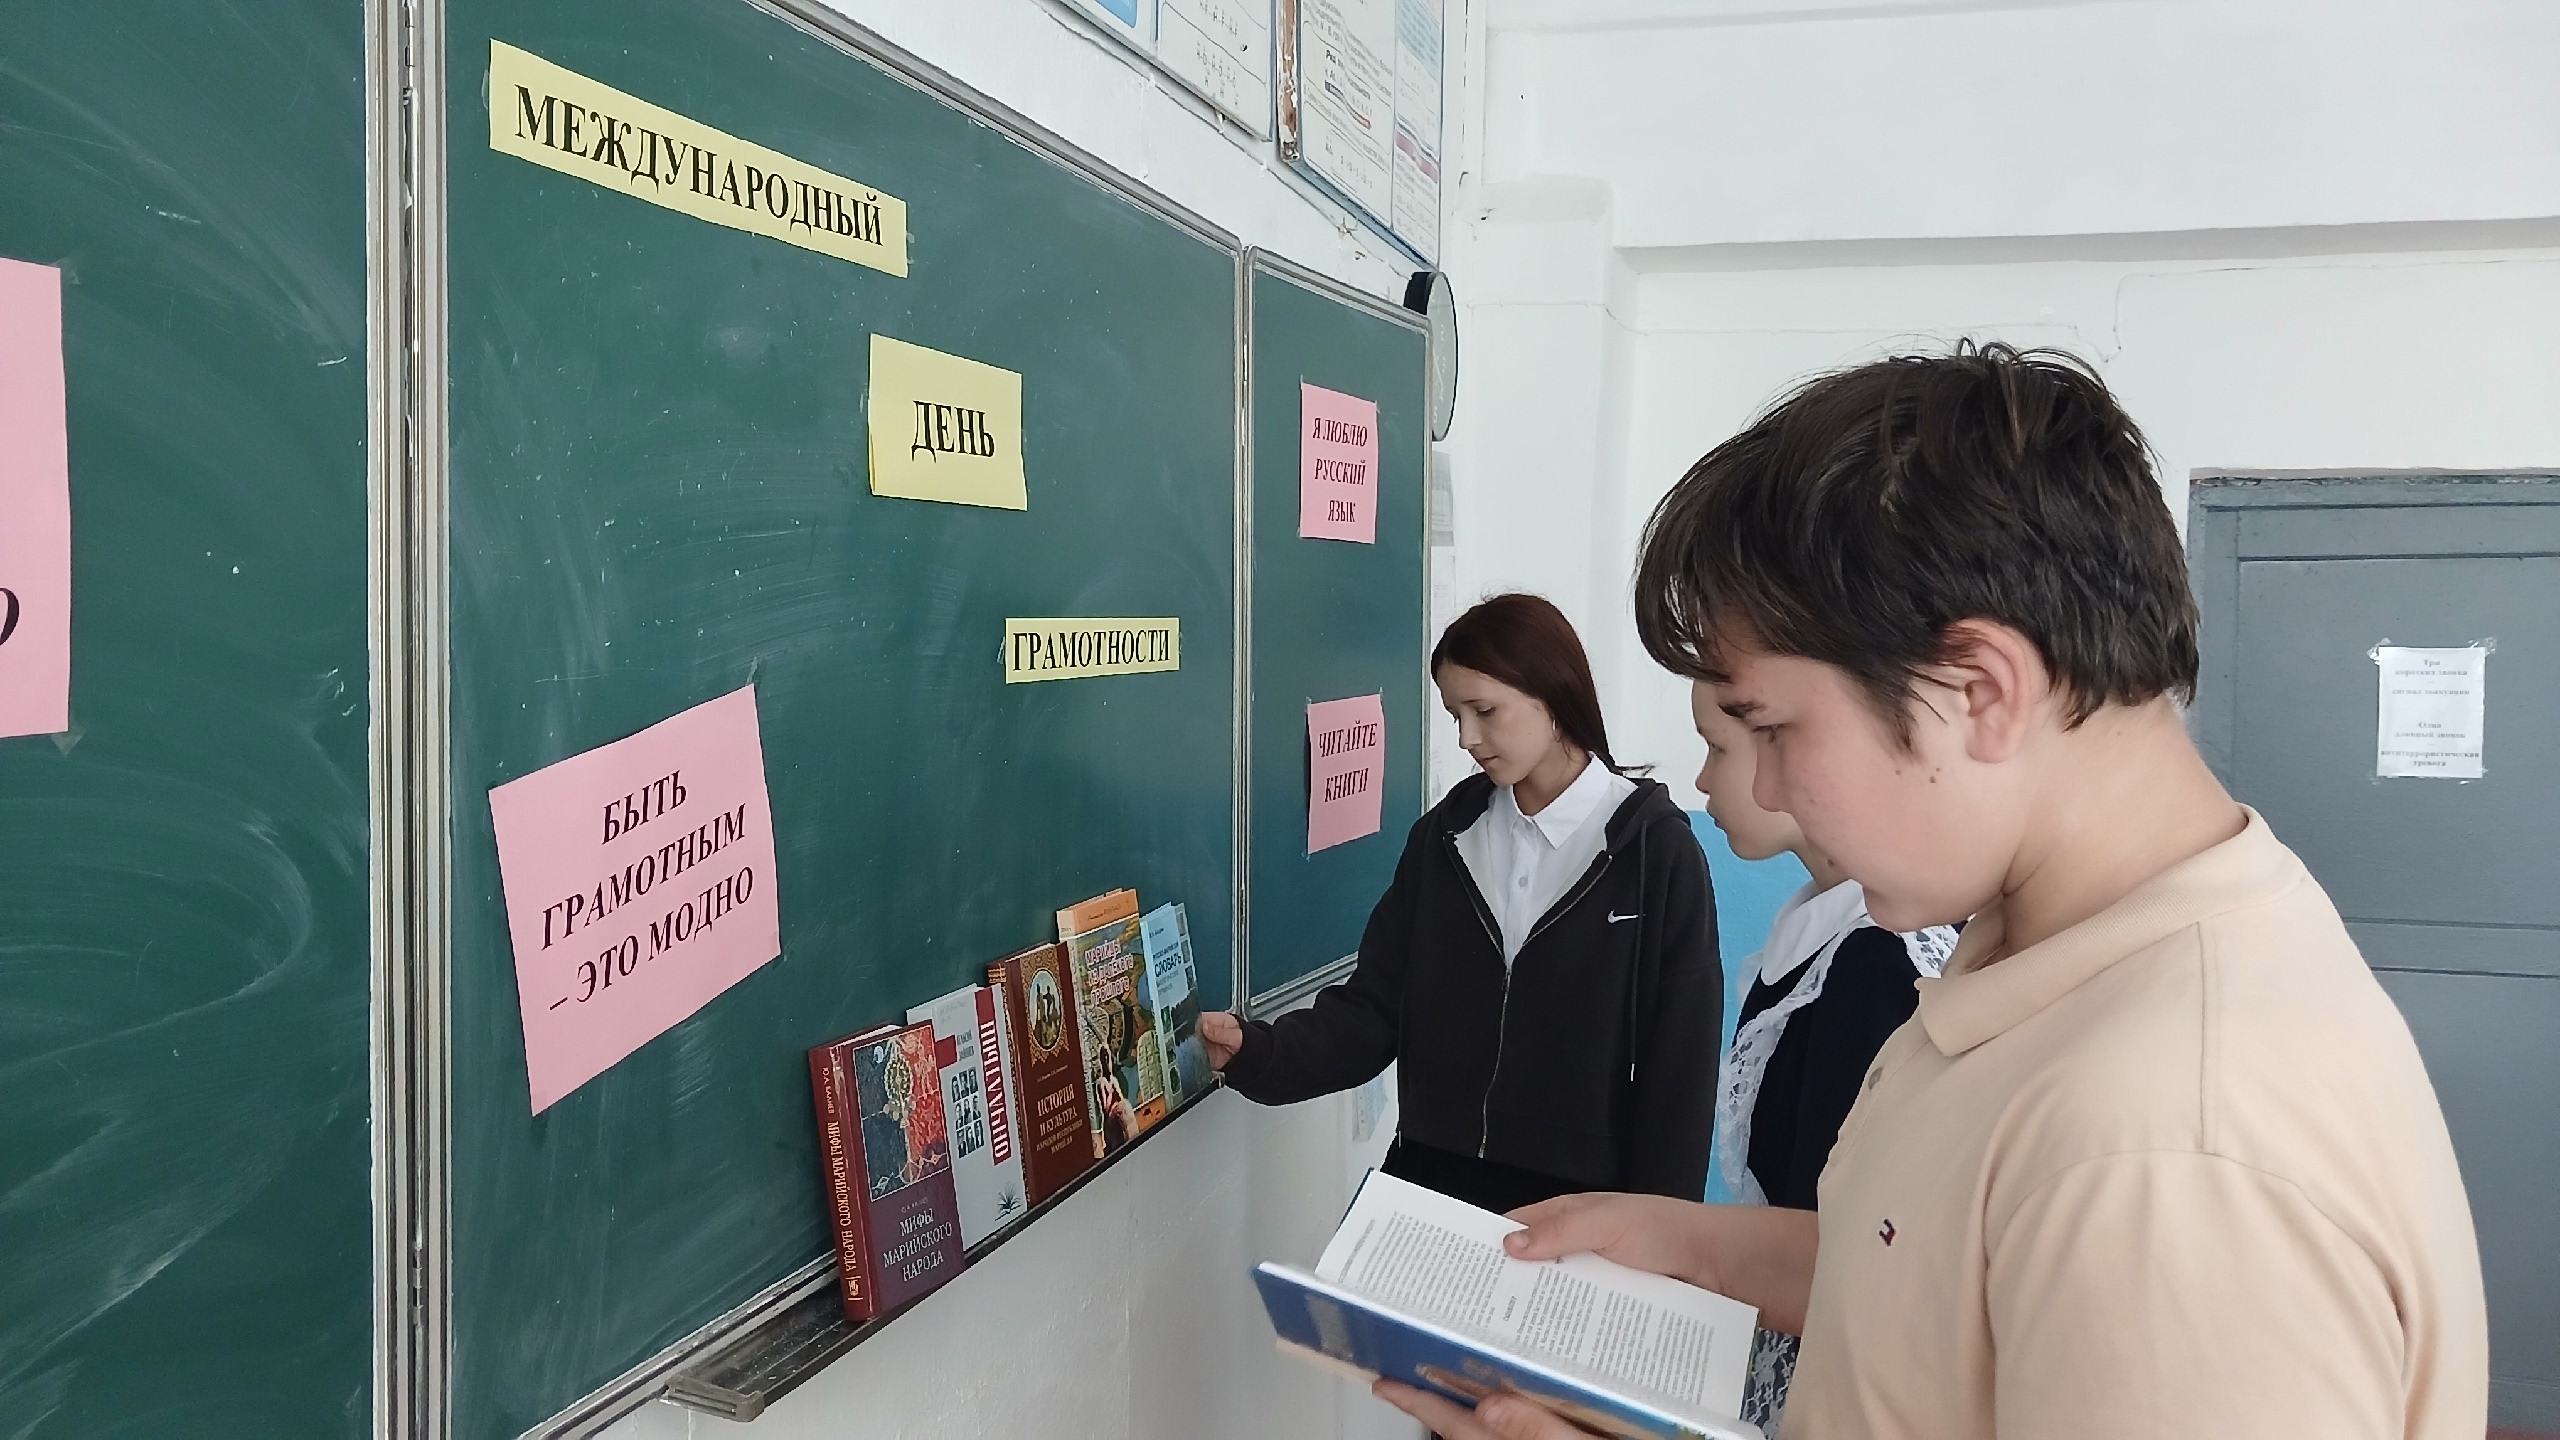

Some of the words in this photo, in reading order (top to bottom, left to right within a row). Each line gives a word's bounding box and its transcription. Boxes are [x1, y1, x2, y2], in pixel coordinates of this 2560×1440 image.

[514, 84, 884, 246] МЕЖДУНАРОДНЫЙ
[911, 399, 996, 464] ДЕНЬ
[1312, 417, 1321, 439] Я
[1323, 419, 1368, 447] ЛЮБЛЮ
[1314, 458, 1367, 486] РУССКИЙ
[1327, 499, 1357, 523] ЯЗЫК
[1012, 629, 1171, 671] ГРАМОТНОСТИ
[1318, 719, 1378, 758] ЧИТАЙТЕ
[1324, 767, 1369, 803] КНИГИ
[602, 770, 688, 845] БЫТЬ
[541, 803, 747, 951] ГРАМОТНЫМ
[576, 934, 639, 1003] ЭТО
[648, 866, 754, 962] МОДНО
[980, 1020, 1009, 1158] ОНЧАЛТЫШ
[1037, 1083, 1075, 1117] ИСТОРИЯ
[827, 1121, 843, 1155] МИФЫ
[832, 1157, 851, 1227] МАРИЙСКОГО
[899, 1208, 934, 1237] МИФЫ
[841, 1230, 857, 1272] НАРОДА
[882, 1221, 952, 1269] МАРИЙСКОГО
[902, 1250, 944, 1282] НАРОДА
